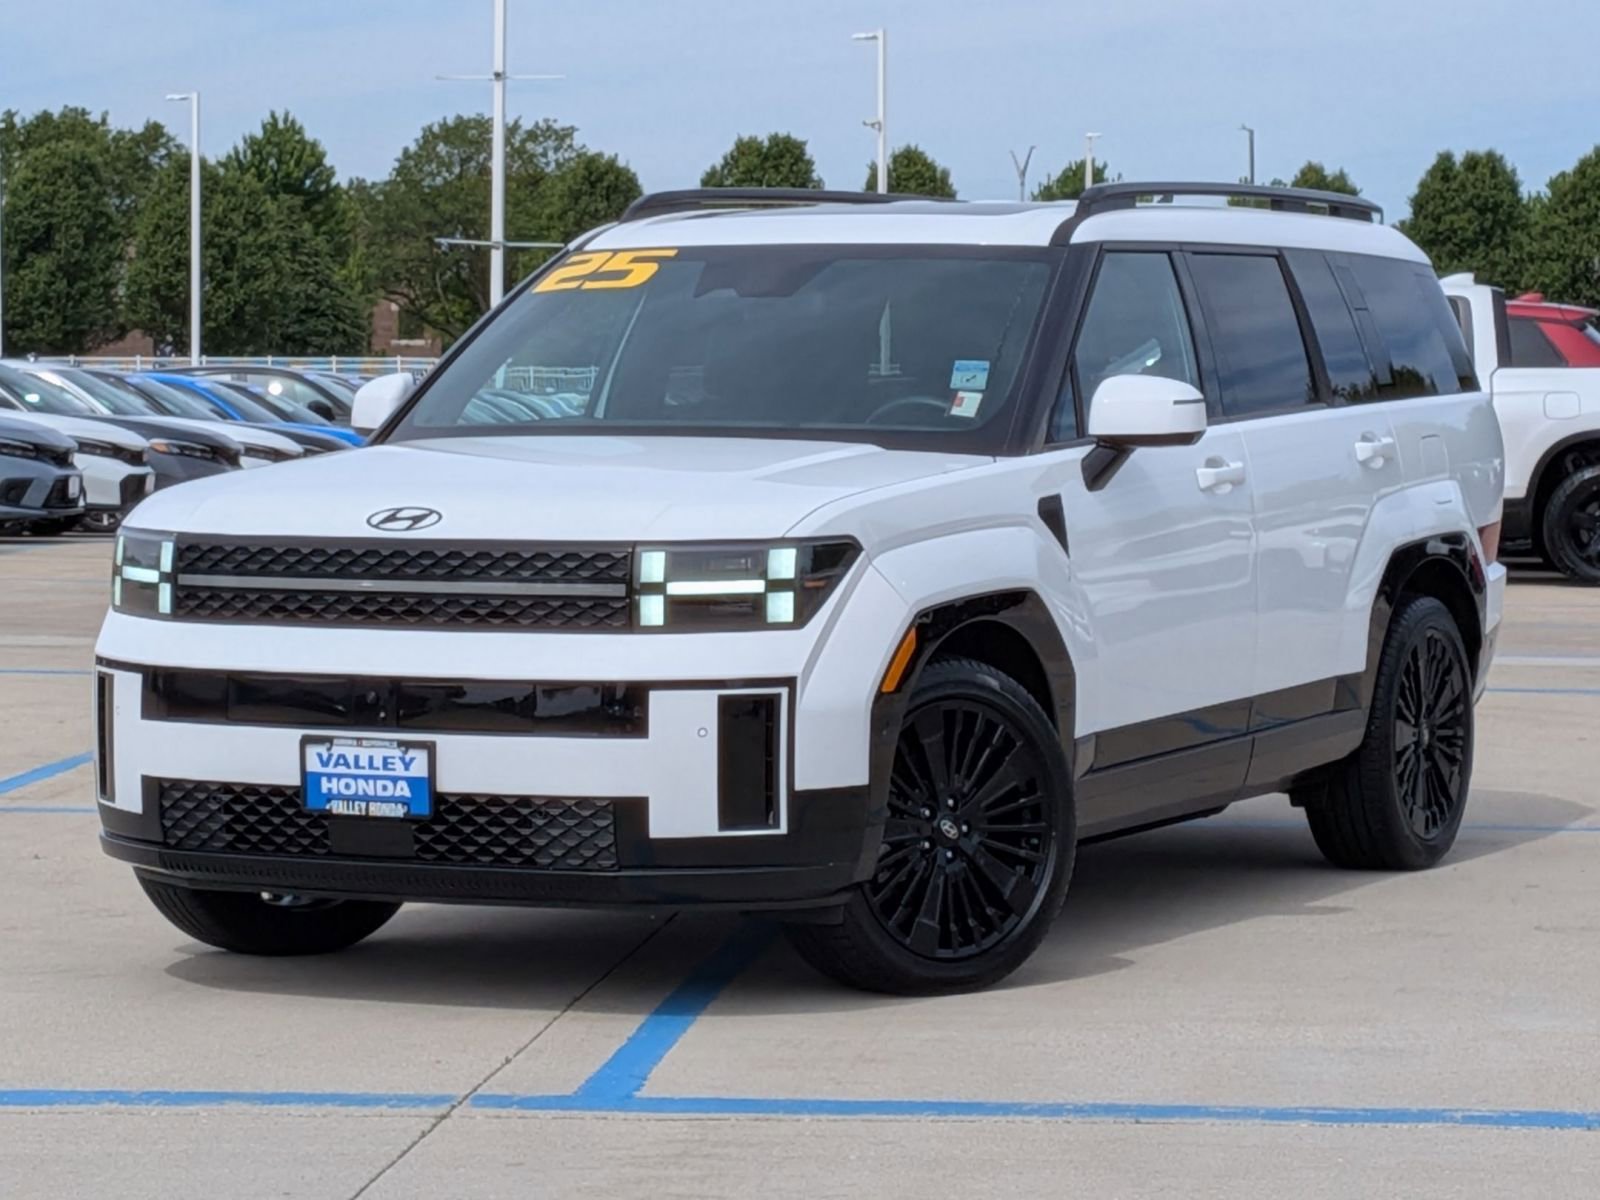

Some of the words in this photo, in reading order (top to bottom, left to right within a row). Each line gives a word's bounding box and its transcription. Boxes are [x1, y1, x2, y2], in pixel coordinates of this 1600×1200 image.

[531, 248, 678, 293] 25
[316, 752, 416, 771] VALLEY
[320, 776, 412, 798] HONDA
